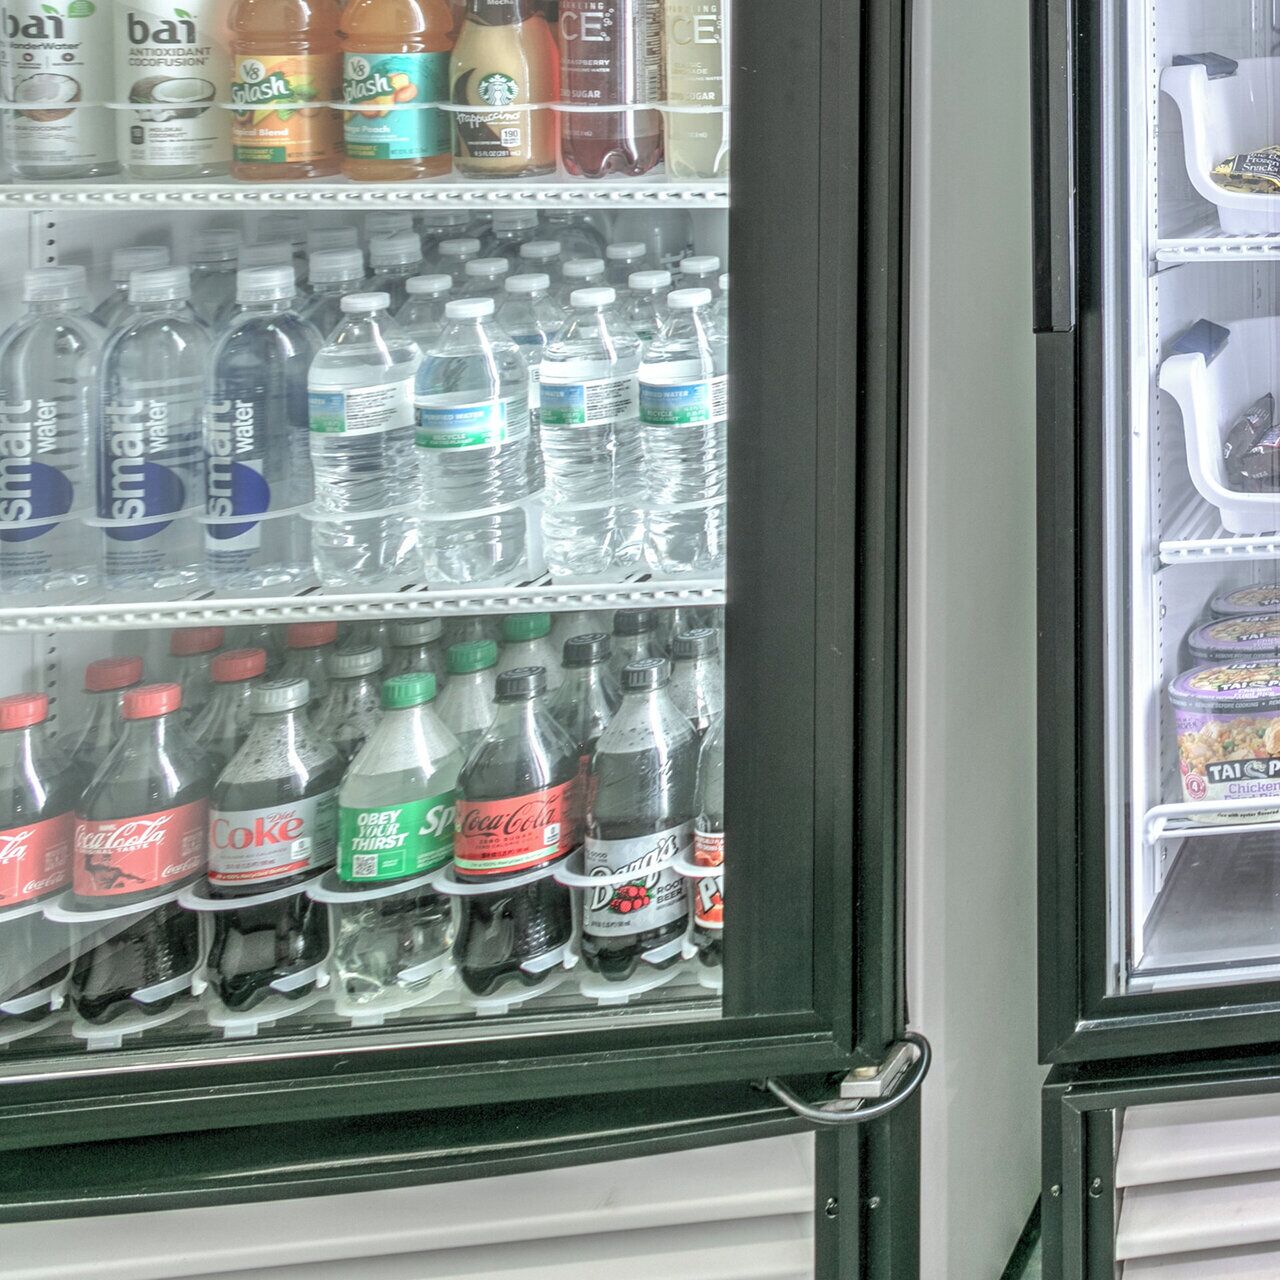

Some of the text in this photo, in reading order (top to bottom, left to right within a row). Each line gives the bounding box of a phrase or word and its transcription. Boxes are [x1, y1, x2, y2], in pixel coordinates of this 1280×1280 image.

[127, 9, 197, 45] bai
[128, 47, 211, 57] ANTIOXIDANT
[128, 58, 206, 67] COCOFUSION
[243, 62, 260, 80] V8
[351, 60, 366, 77] V8
[232, 76, 290, 107] Splash
[1241, 163, 1279, 172] Snacks
[37, 398, 58, 454] water
[149, 398, 169, 454] water
[235, 398, 254, 454] water
[105, 398, 146, 521] smart
[205, 398, 234, 518] smart
[1209, 762, 1241, 780] TAI
[357, 809, 403, 826] OBEY
[461, 794, 562, 838] Coca-Cola
[211, 817, 304, 850] Coke
[359, 823, 400, 837] YOUR
[352, 832, 409, 851] THIRST
[656, 878, 684, 894] ROOT
[656, 888, 683, 904] BEER
